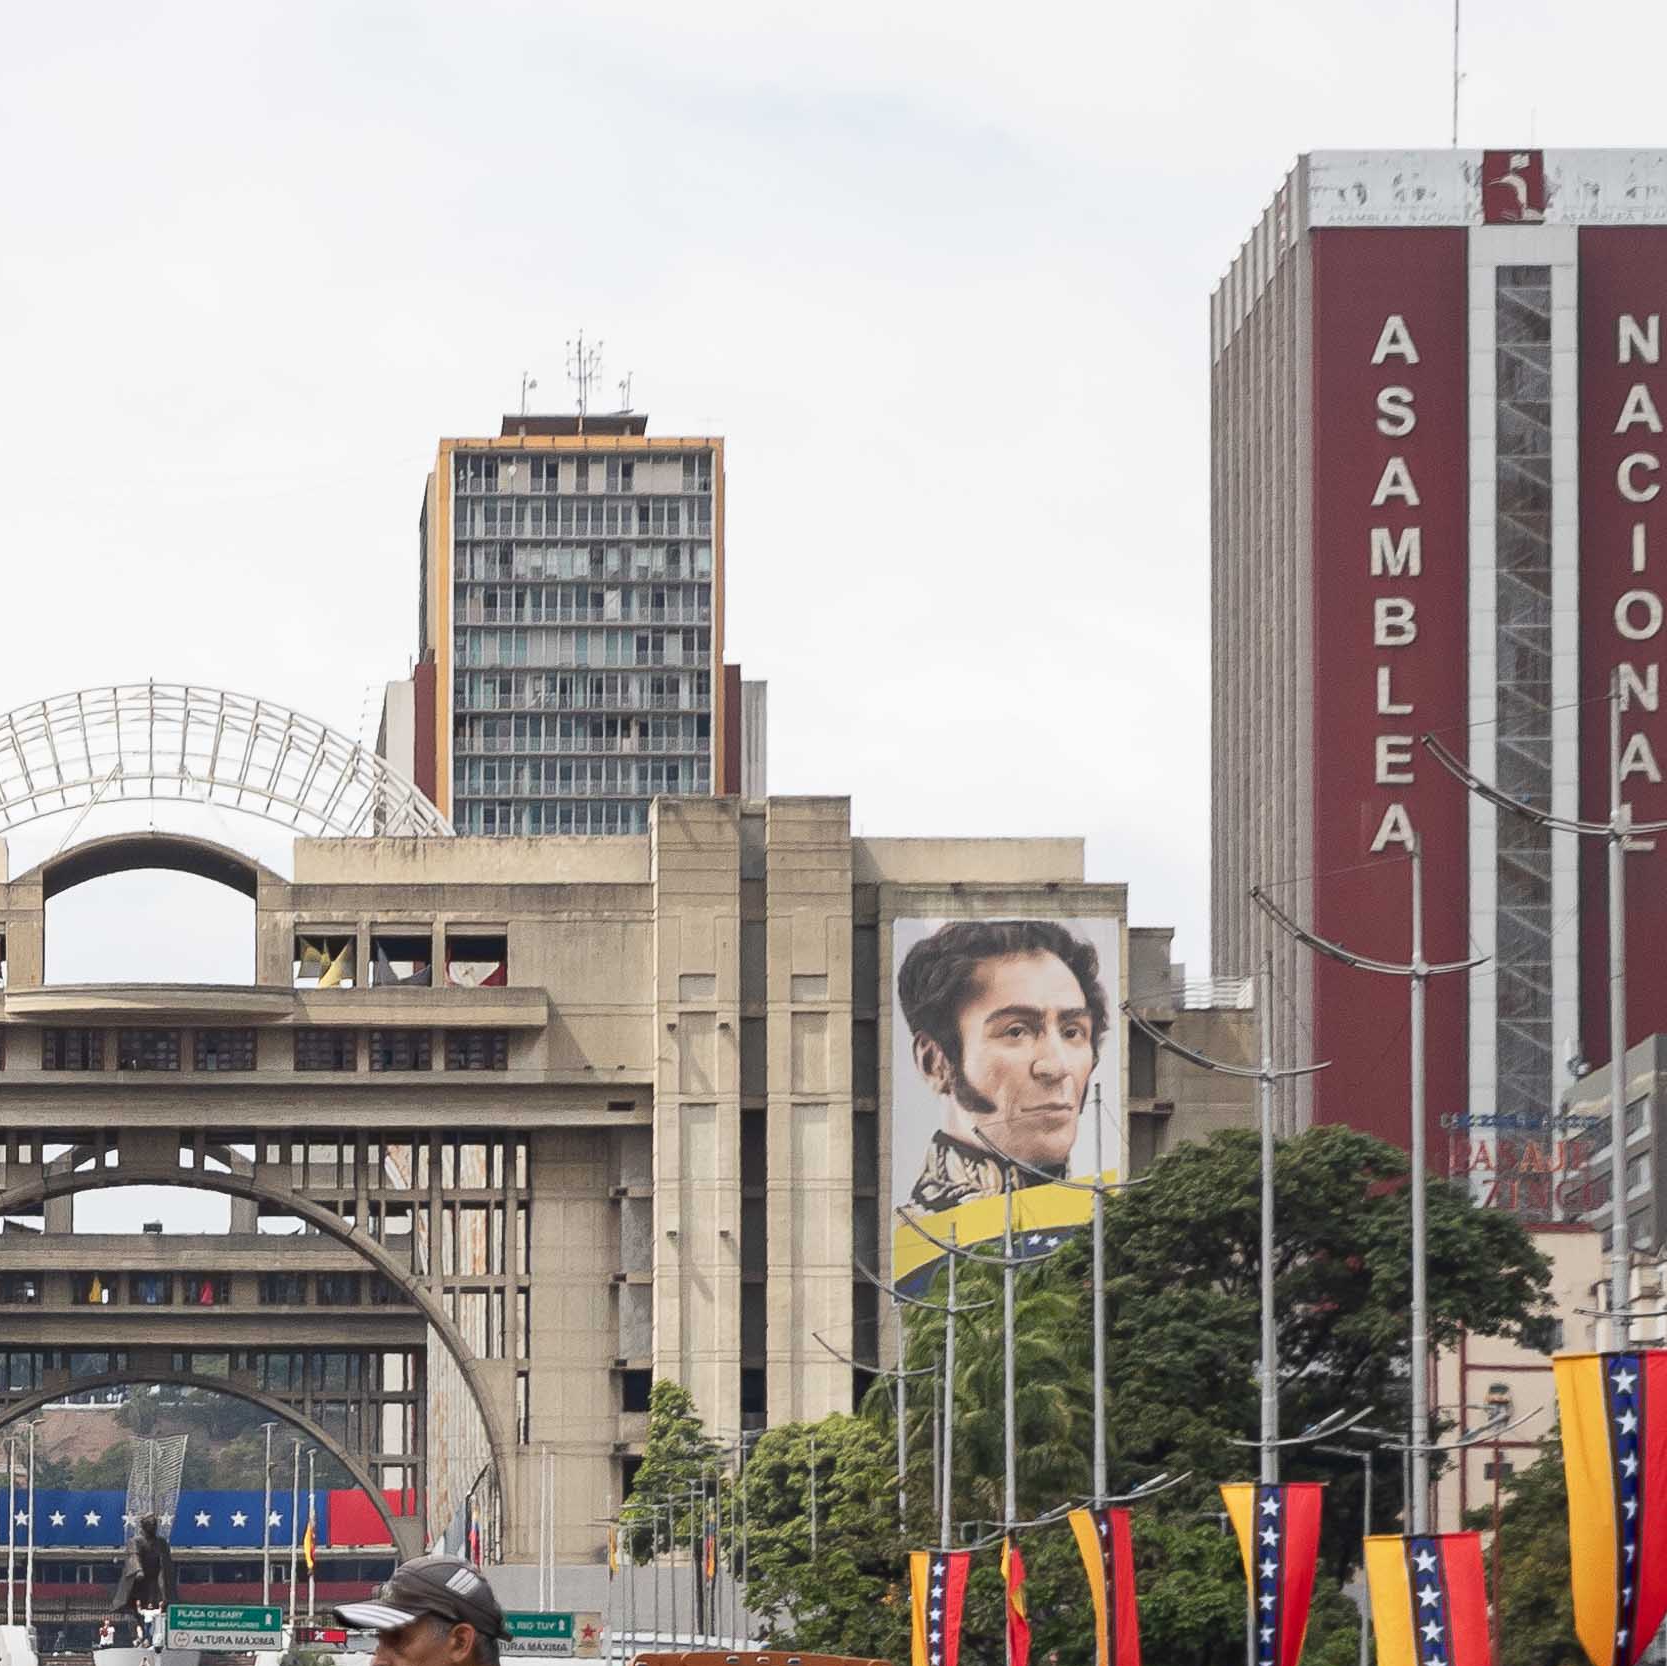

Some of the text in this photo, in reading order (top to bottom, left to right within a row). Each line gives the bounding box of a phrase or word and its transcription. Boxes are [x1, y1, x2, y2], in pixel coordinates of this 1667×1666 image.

[1370, 314, 1422, 853] ASAMBLEA
[1614, 314, 1663, 852] NACIONAL
[177, 1609, 205, 1618] PLAZA
[536, 1621, 555, 1630] TUY
[193, 1634, 233, 1645] ALTURA
[234, 1634, 276, 1646] MÁXIMA
[499, 1641, 525, 1651] TURA
